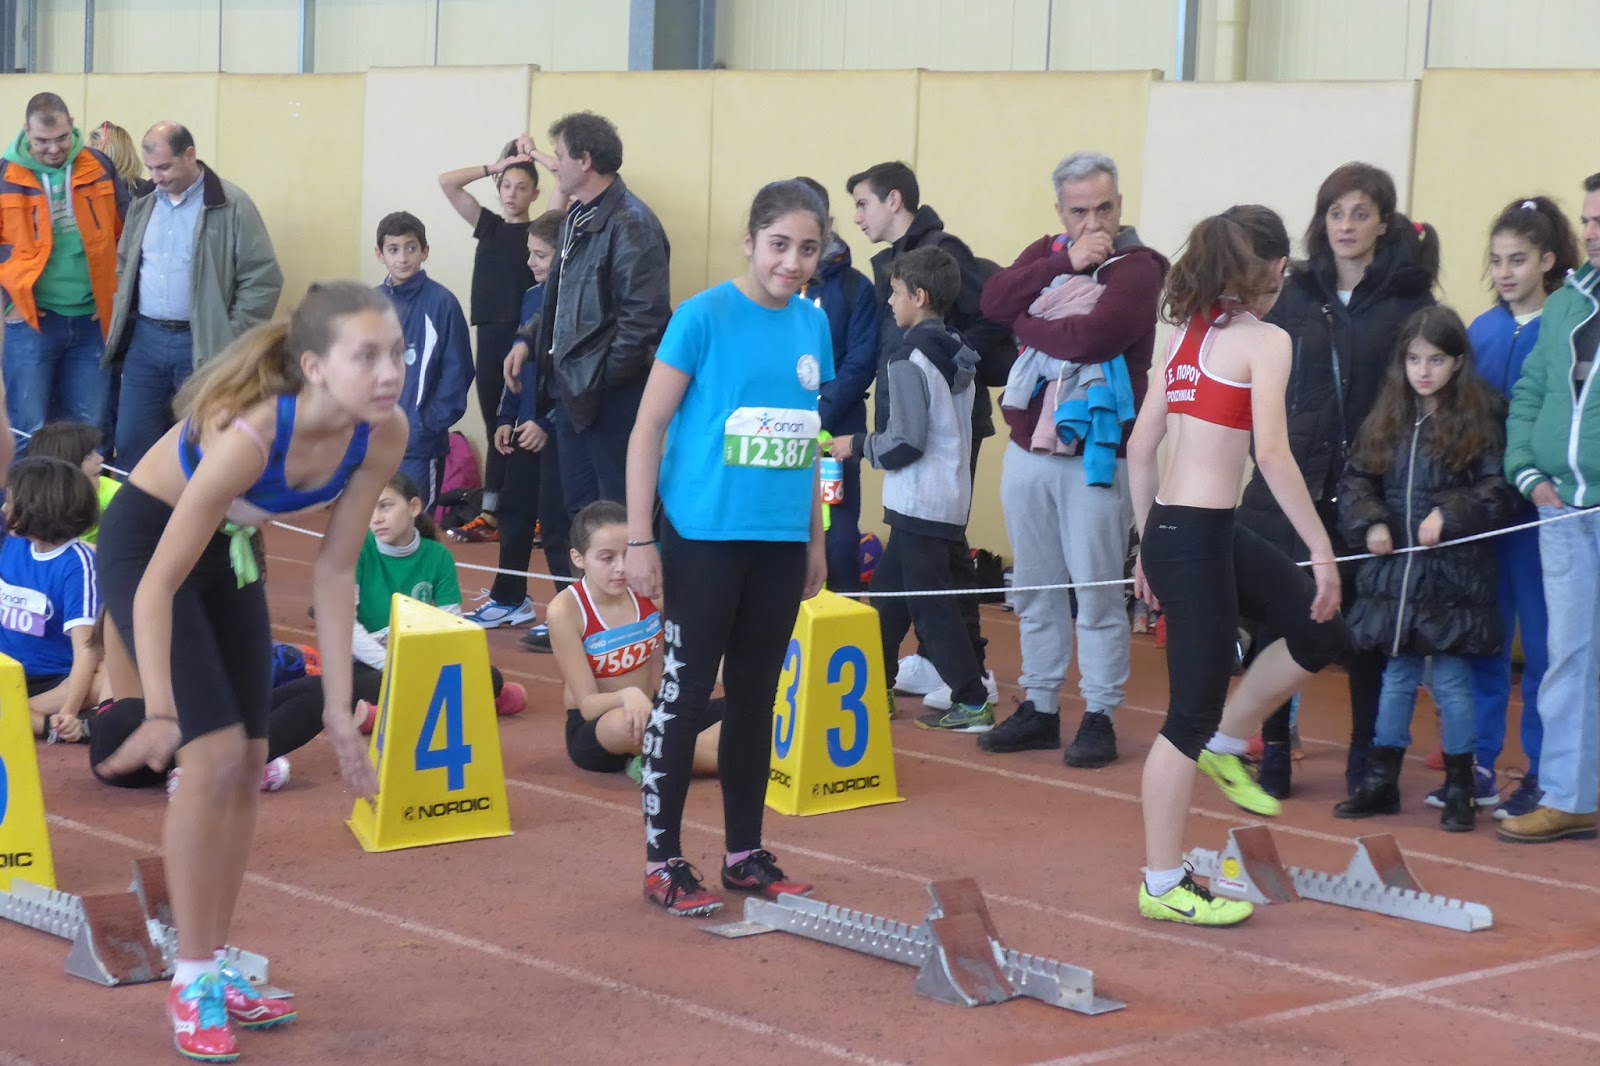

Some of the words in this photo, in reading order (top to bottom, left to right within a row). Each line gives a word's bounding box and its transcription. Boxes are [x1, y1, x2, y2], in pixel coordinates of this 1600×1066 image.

[1176, 364, 1201, 386] ΠΟΡΟΥ
[738, 436, 810, 467] 12387
[774, 638, 802, 760] 3
[825, 644, 870, 769] 3
[415, 663, 472, 792] 4
[642, 731, 663, 759] 91
[769, 768, 791, 788] ORDIC
[822, 775, 881, 796] NORDIC
[417, 797, 491, 820] NORDIC
